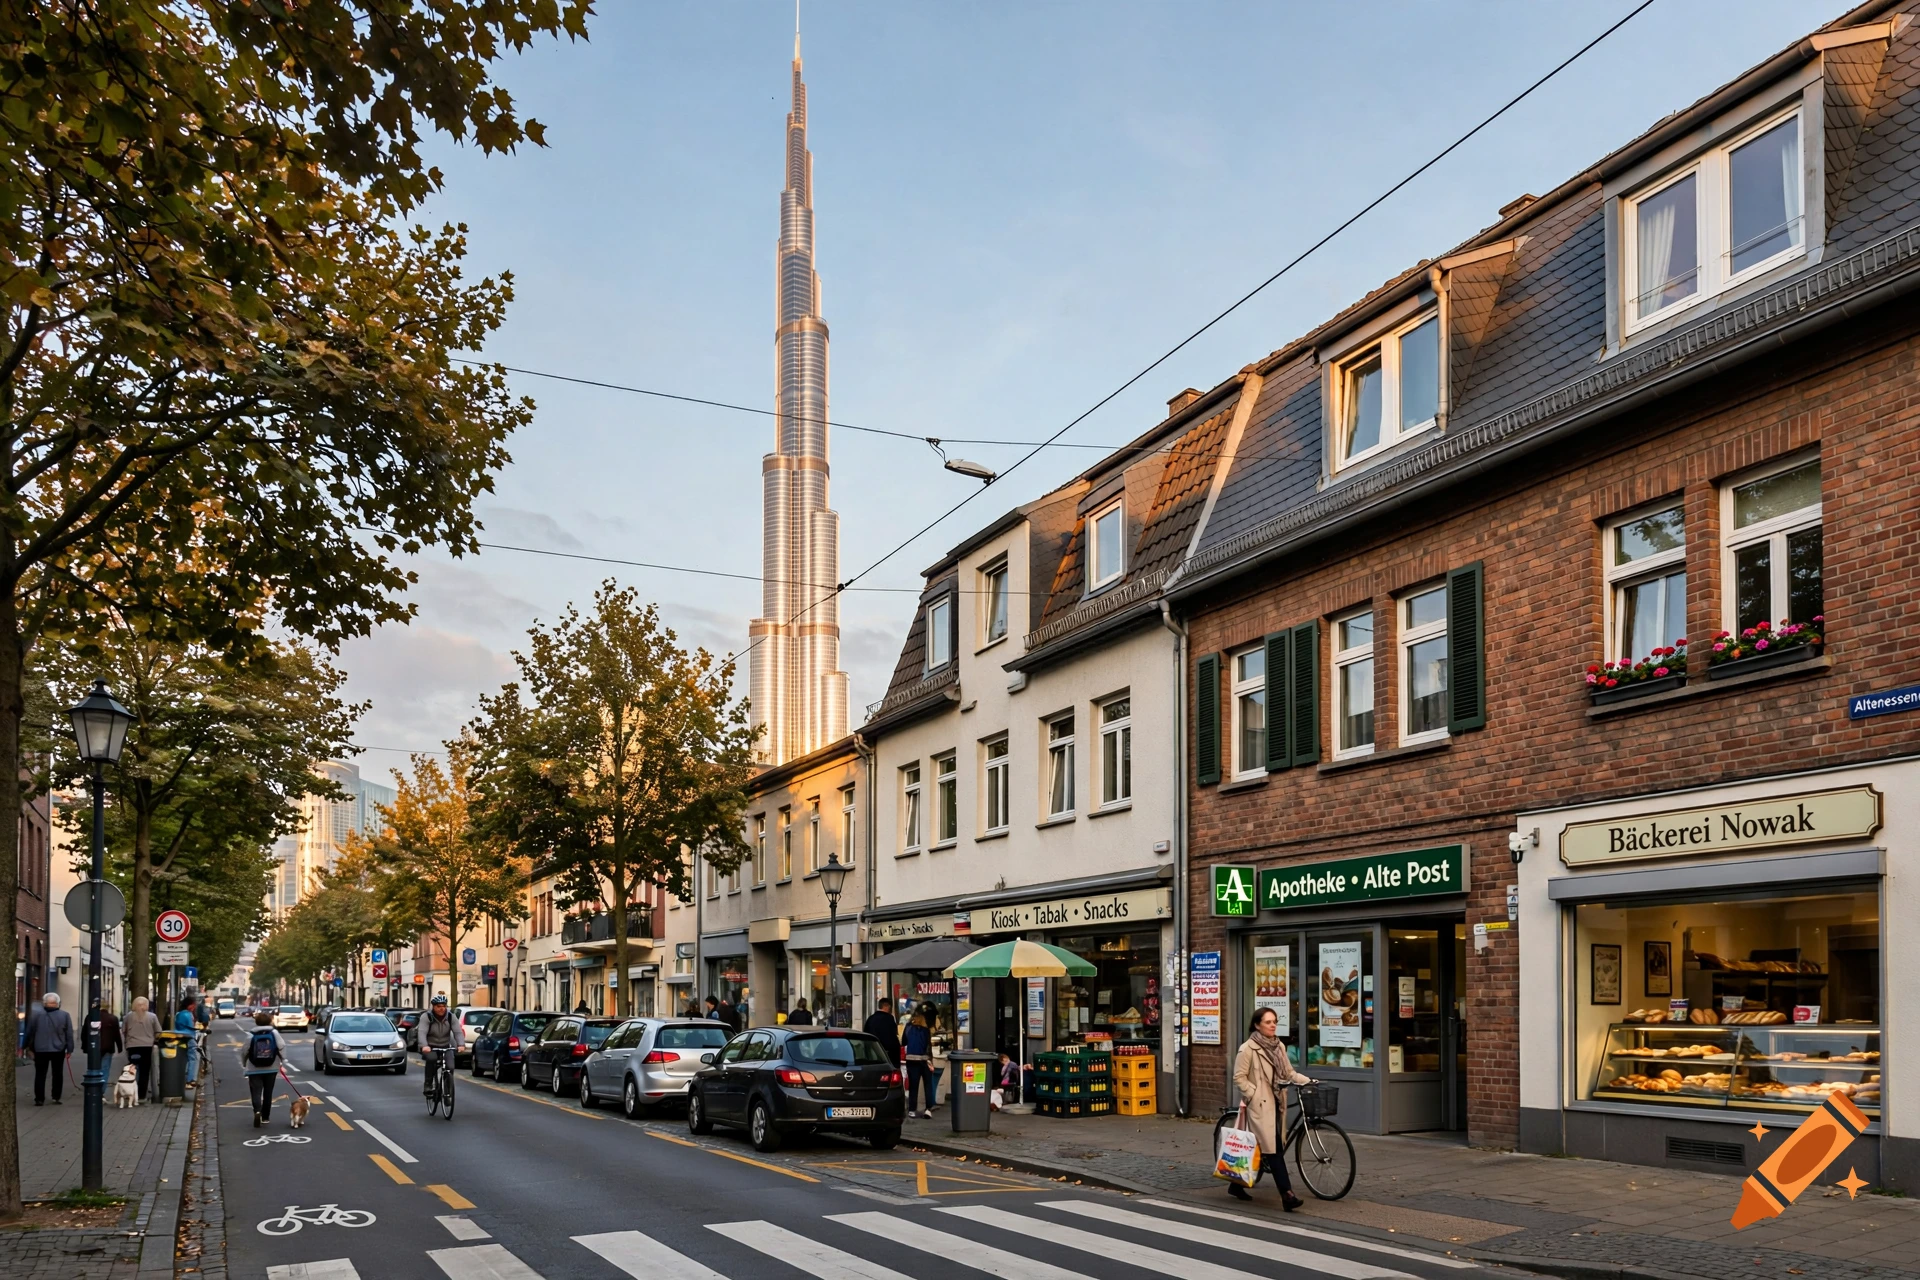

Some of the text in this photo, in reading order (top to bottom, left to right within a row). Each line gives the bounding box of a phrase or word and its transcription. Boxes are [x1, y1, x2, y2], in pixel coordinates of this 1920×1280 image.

[1854, 692, 1920, 713] Altenessen
[1608, 803, 1815, 853] Bäckerei Nowak
[1219, 869, 1252, 901] A
[1268, 859, 1450, 903] Apotheke Alte Post
[163, 919, 183, 932] 30
[991, 897, 1129, 929] Kiosk Tabak Snacks
